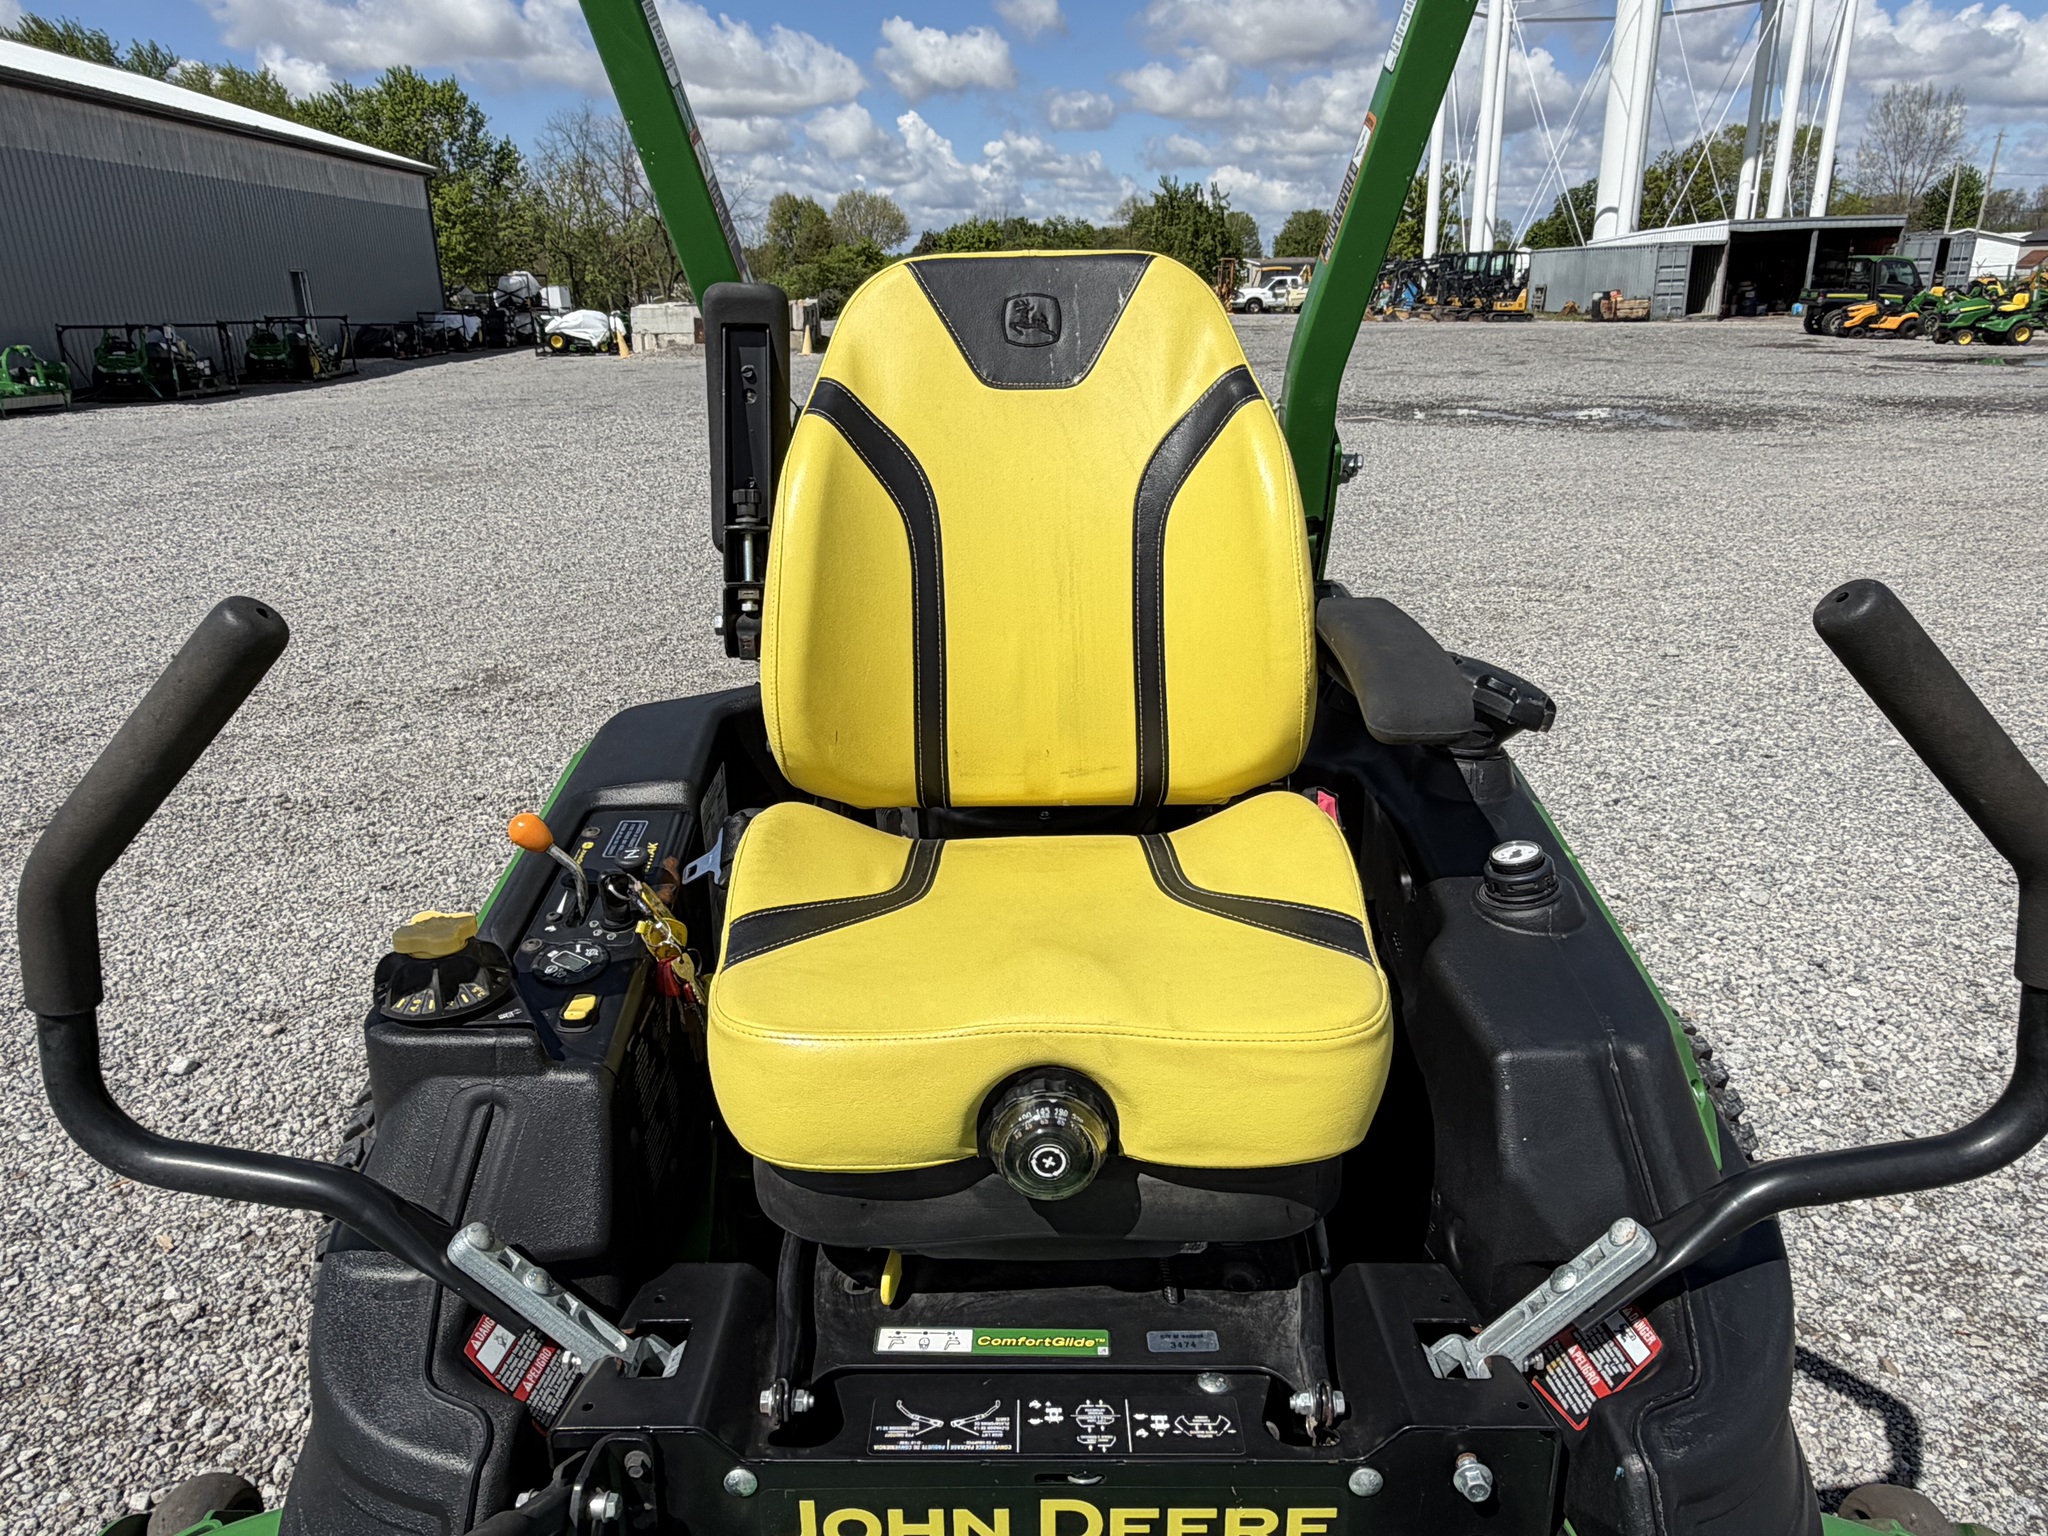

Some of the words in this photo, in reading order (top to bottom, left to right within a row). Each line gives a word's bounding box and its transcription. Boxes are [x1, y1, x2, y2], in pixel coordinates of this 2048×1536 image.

[1170, 1341, 1197, 1349] 3474
[1630, 1314, 1657, 1345] DANGER
[528, 1348, 553, 1383] PELIGRO
[1571, 1352, 1600, 1386] PELIGRO
[798, 1500, 1009, 1536] JOHN
[1040, 1499, 1338, 1536] DEERE
